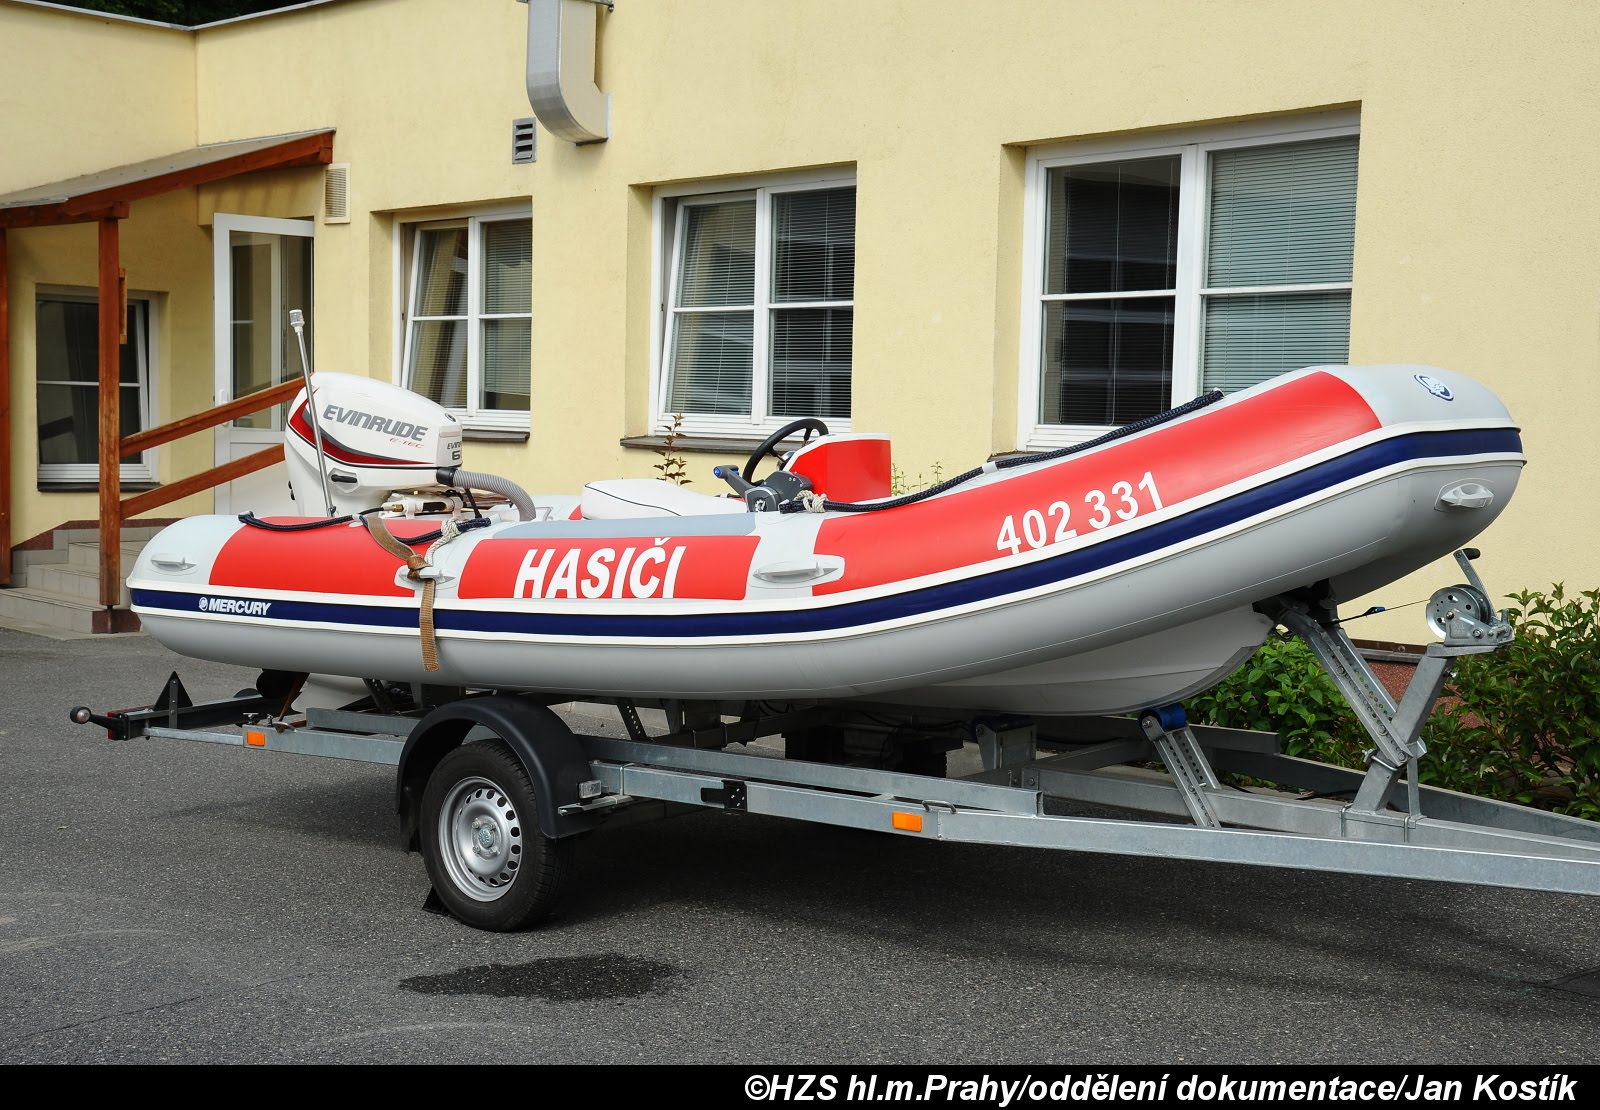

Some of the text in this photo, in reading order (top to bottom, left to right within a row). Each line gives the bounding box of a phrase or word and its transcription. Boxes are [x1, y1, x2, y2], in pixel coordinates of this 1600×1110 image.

[323, 404, 428, 442] EVINRUDE
[996, 471, 1163, 555] 402 331
[513, 537, 687, 599] HASIČI
[209, 598, 272, 615] MERCURY
